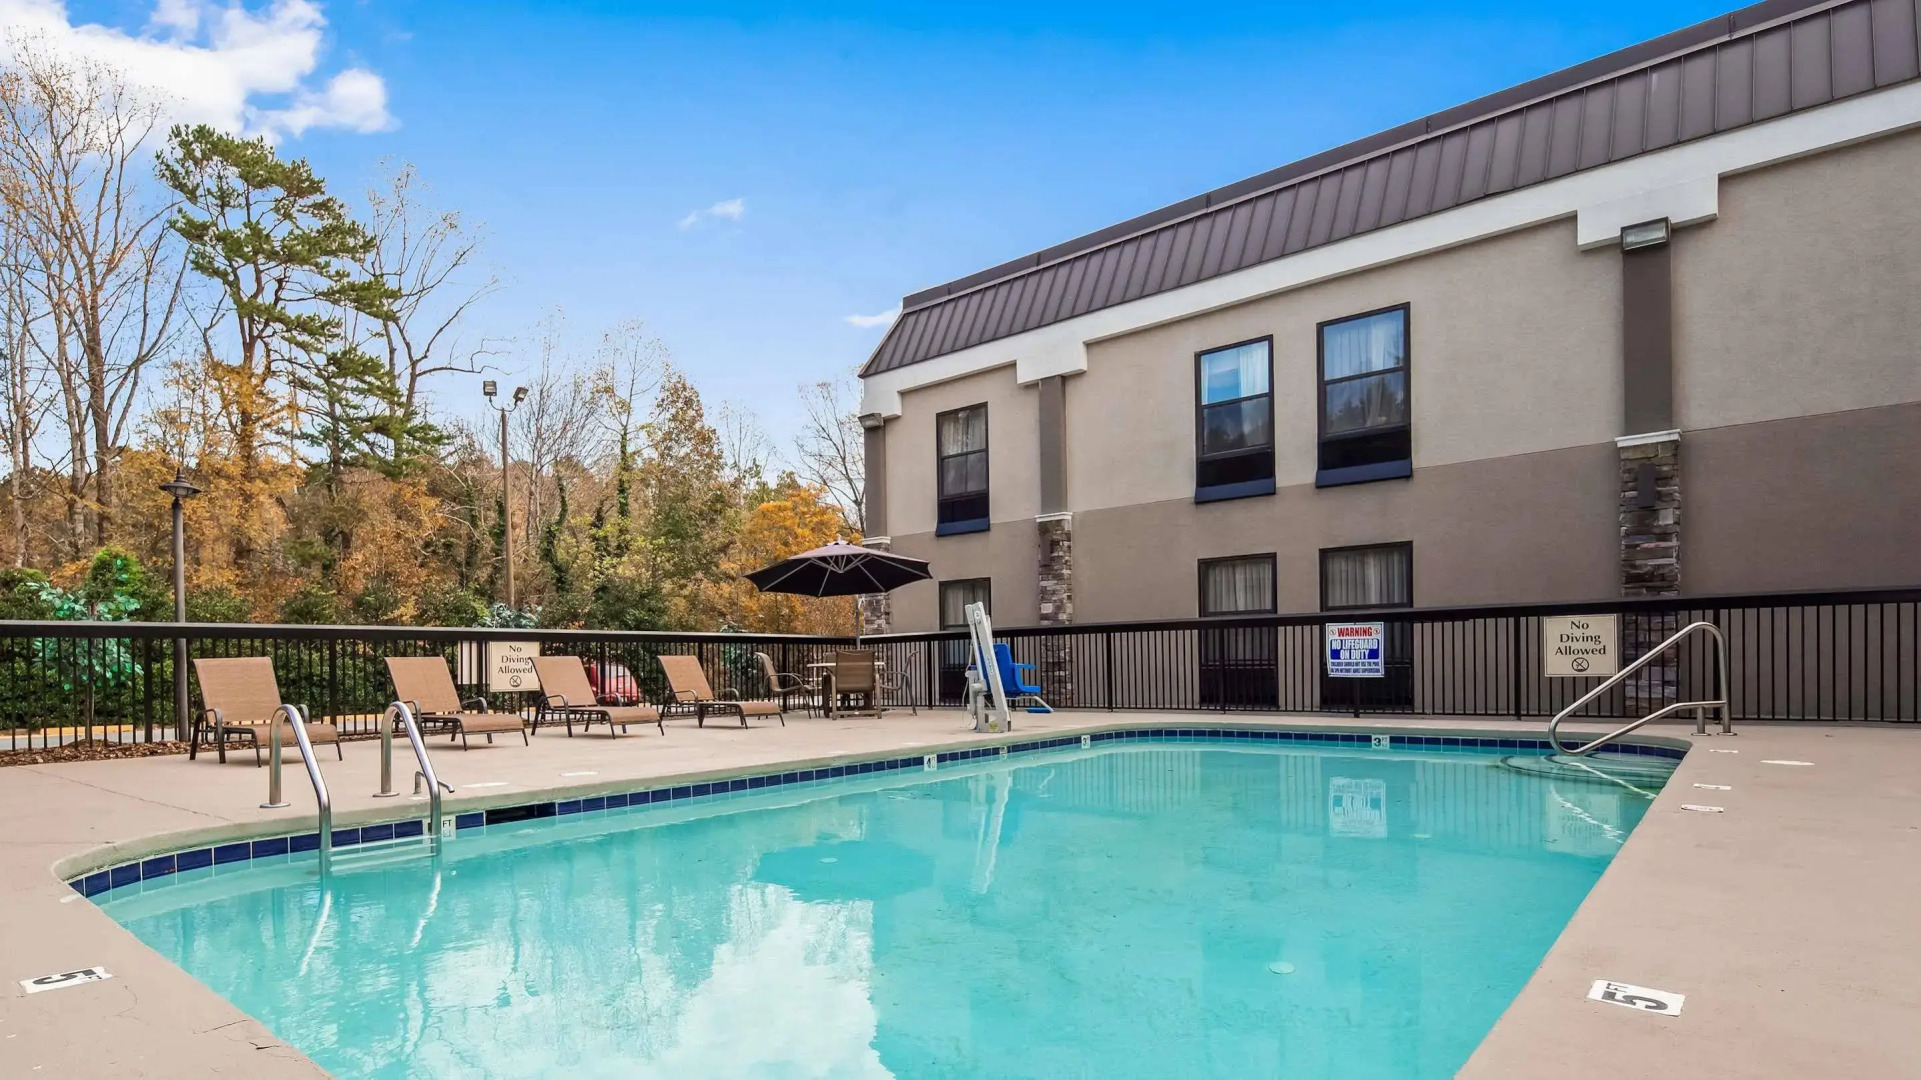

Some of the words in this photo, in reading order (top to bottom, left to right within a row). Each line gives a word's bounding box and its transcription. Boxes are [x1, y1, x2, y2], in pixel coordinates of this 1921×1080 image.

[1570, 620, 1589, 630] No
[1337, 627, 1373, 637] WARNING
[1560, 632, 1601, 645] Diving
[509, 645, 522, 653] No
[1331, 639, 1341, 650] NO
[1342, 639, 1378, 650] LIFEGUARD
[1340, 649, 1350, 660] ON
[1351, 649, 1369, 660] DUTY
[1554, 645, 1606, 656] Allowed
[501, 655, 530, 666] Diving
[498, 665, 533, 674] Allowed
[443, 819, 452, 828] FT
[32, 969, 97, 985] 5
[1601, 990, 1669, 1011] 5
